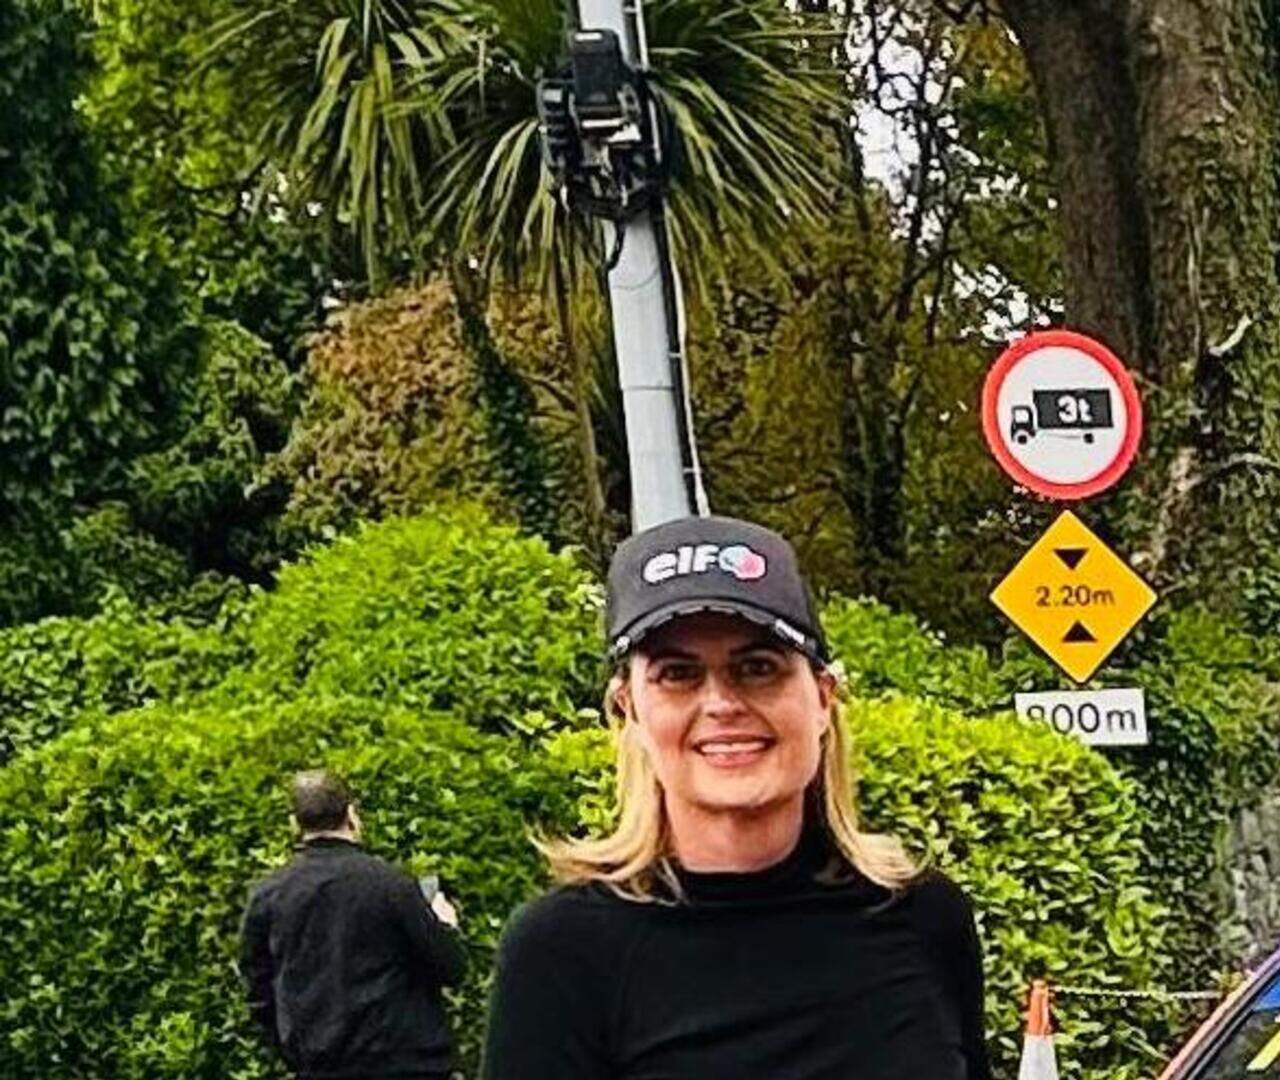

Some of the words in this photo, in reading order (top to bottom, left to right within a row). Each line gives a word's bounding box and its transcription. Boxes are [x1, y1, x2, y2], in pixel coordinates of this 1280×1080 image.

[1057, 395, 1093, 424] 3t
[643, 544, 720, 584] elf
[1036, 584, 1115, 607] 2.20m
